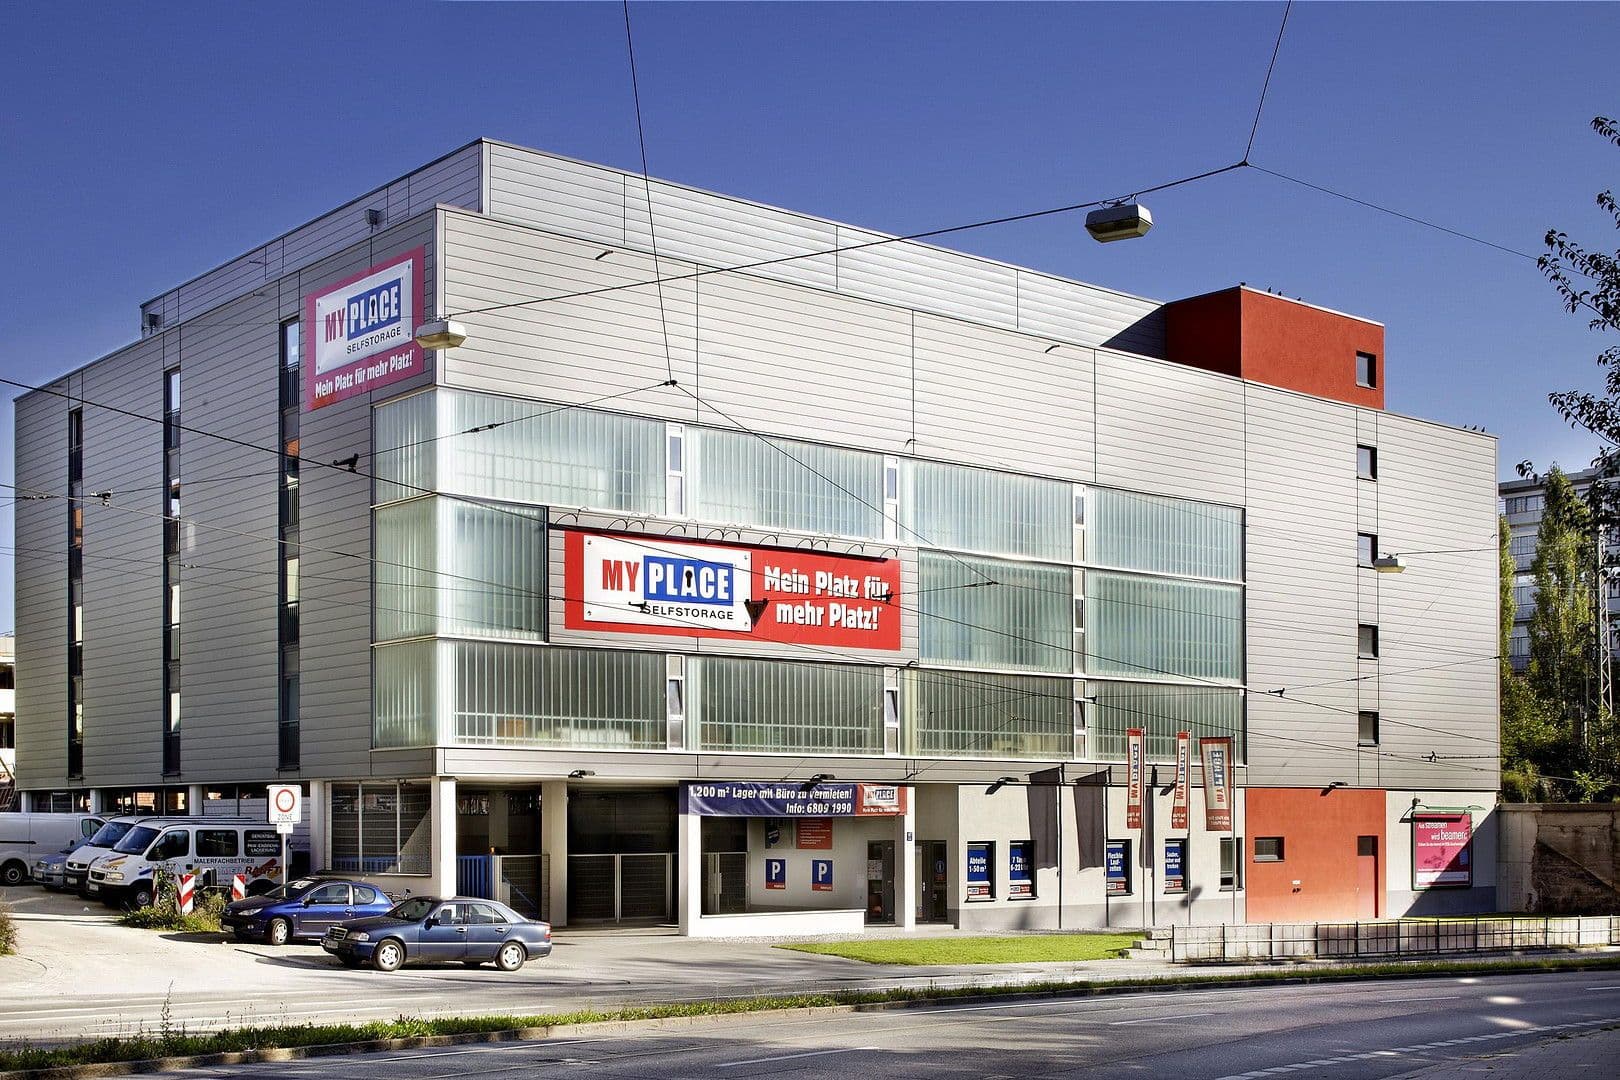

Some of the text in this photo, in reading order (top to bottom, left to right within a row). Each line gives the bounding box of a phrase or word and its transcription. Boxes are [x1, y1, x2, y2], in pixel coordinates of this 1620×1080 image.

[325, 286, 398, 343] MY PLACE
[347, 326, 401, 354] SELFSTORAGE
[315, 380, 333, 399] Mein
[335, 373, 353, 391] Platz
[355, 367, 365, 384] für
[367, 360, 388, 379] mehr
[602, 559, 730, 600] MY PLACE
[764, 565, 889, 600] Mein Platz für
[644, 606, 734, 620] SELFSTORAGE
[776, 601, 825, 626] mehr
[732, 787, 757, 799] Lager
[759, 788, 773, 799] mit
[776, 788, 795, 799] Büro
[797, 790, 807, 798] zu
[809, 788, 853, 800] vermieten!
[786, 802, 852, 814] Info: 6809 1990
[771, 861, 780, 880] P
[818, 862, 827, 882] P
